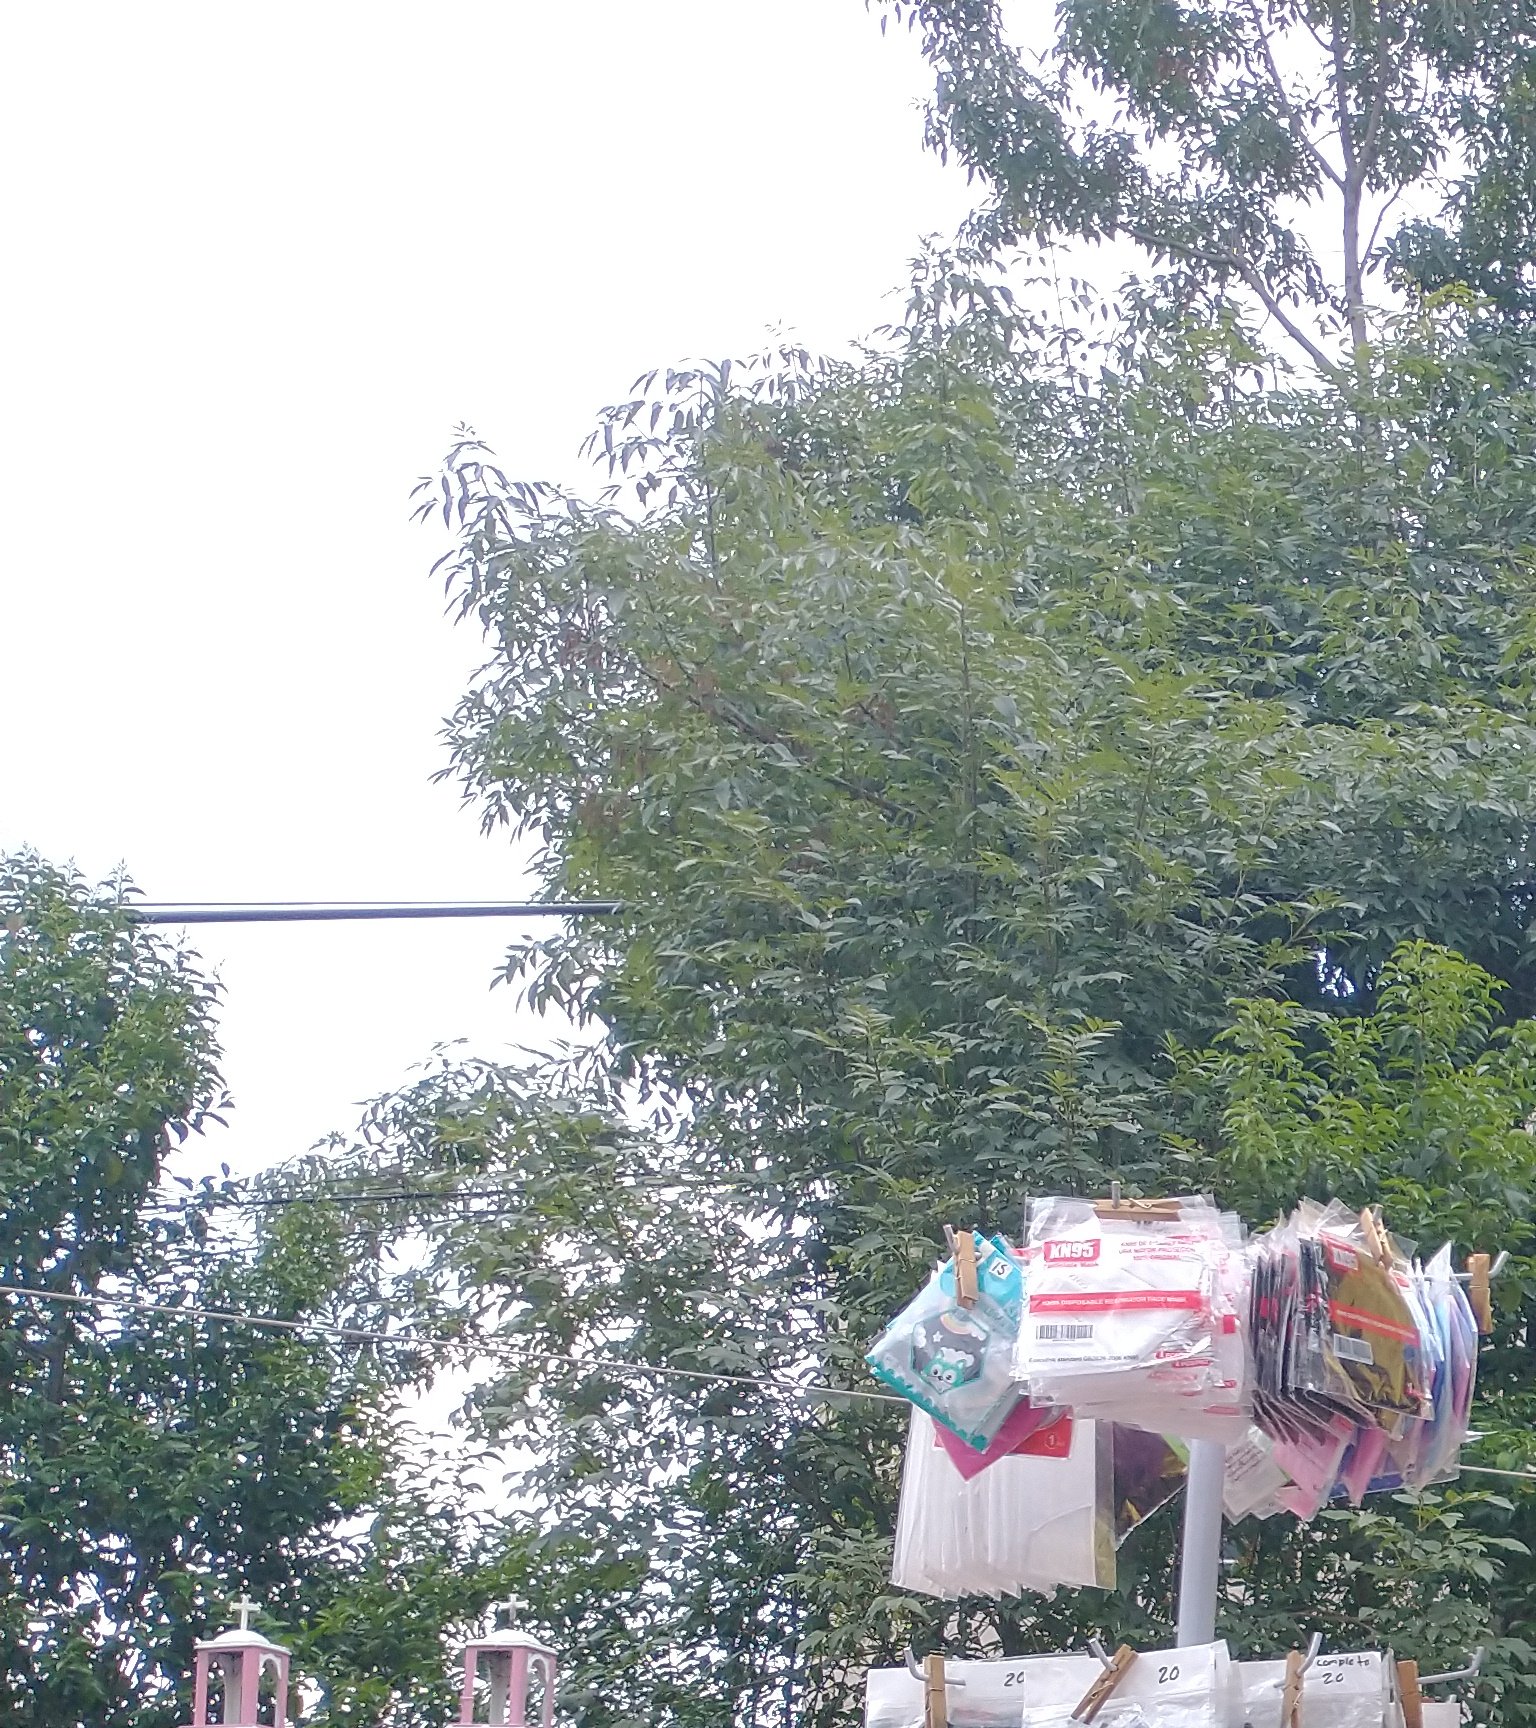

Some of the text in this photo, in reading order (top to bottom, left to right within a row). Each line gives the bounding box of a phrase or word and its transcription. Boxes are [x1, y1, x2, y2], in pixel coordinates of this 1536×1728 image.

[1049, 1241, 1094, 1259] KN95
[1158, 1666, 1180, 1684] 20
[1322, 1672, 1344, 1685] 20
